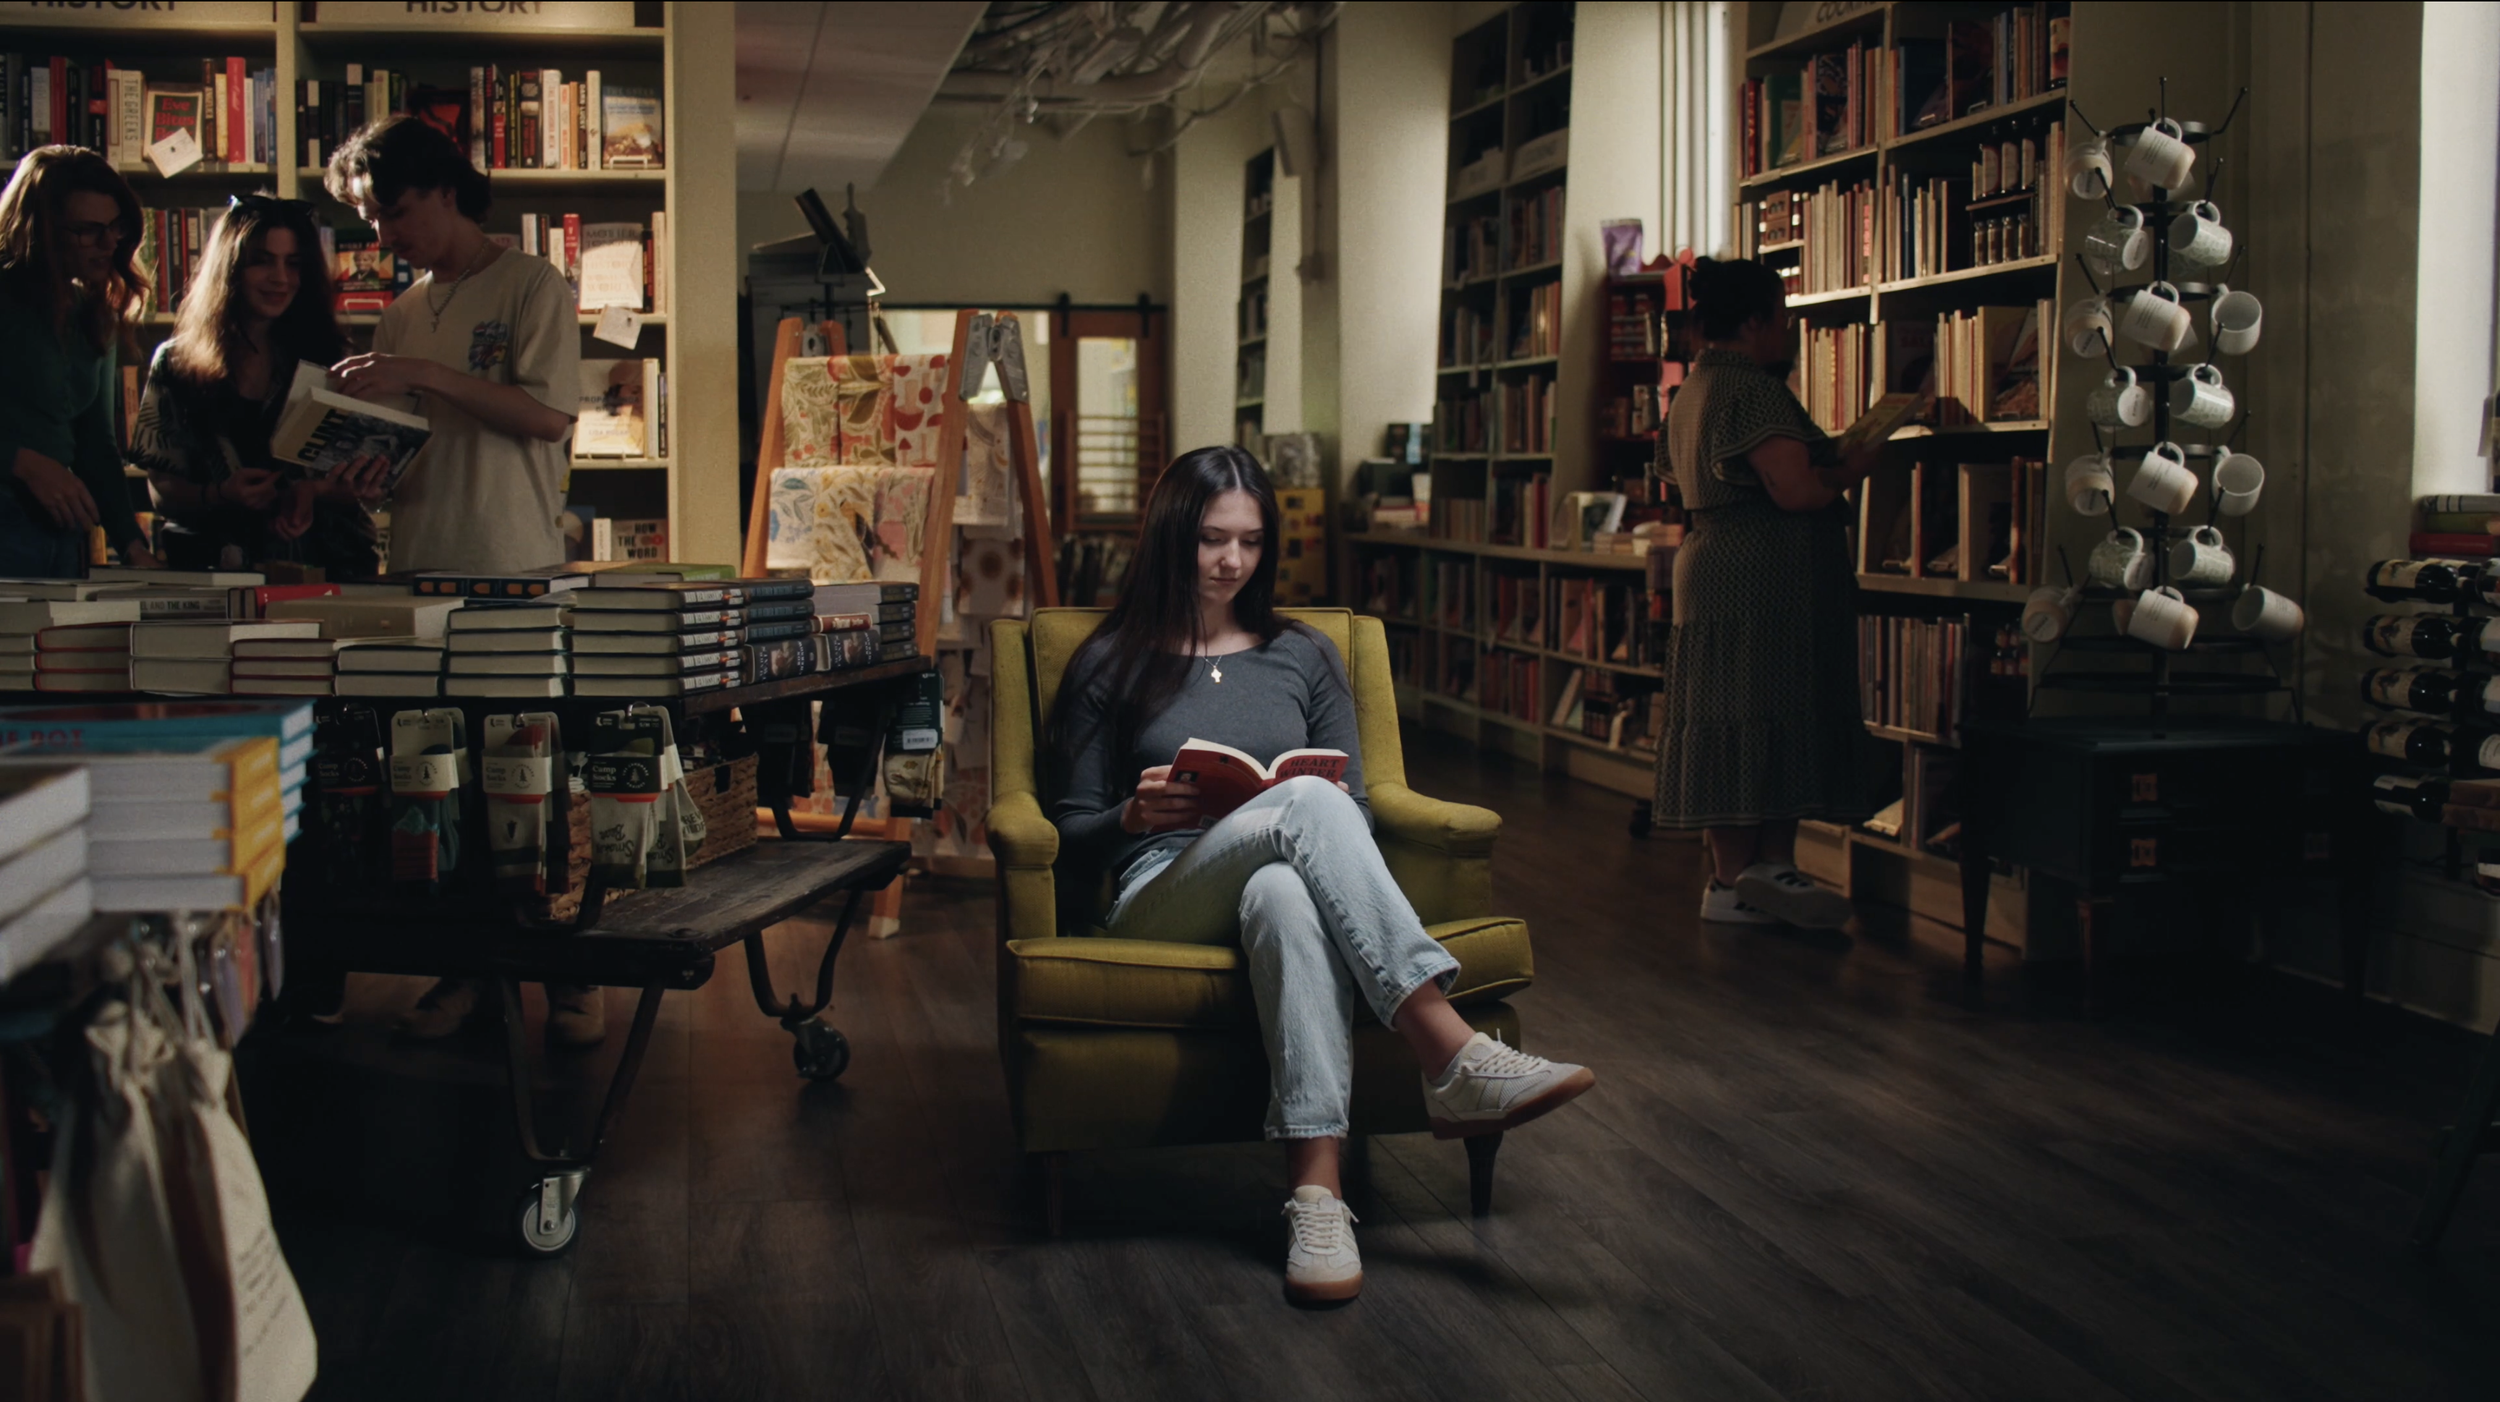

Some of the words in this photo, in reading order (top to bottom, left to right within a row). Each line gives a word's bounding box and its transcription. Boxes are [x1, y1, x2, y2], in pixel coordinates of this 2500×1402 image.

[162, 98, 190, 111] Eve
[155, 112, 195, 126] Bites
[297, 408, 349, 461] CLINT
[635, 523, 656, 533] HOW
[618, 535, 636, 547] THE
[627, 547, 658, 559] WORD
[167, 601, 180, 610] THE
[182, 601, 200, 610] KING
[1291, 758, 1339, 768] HEART
[592, 765, 617, 774] Camp
[1280, 767, 1336, 778] WINTER
[592, 773, 617, 782] Socks
